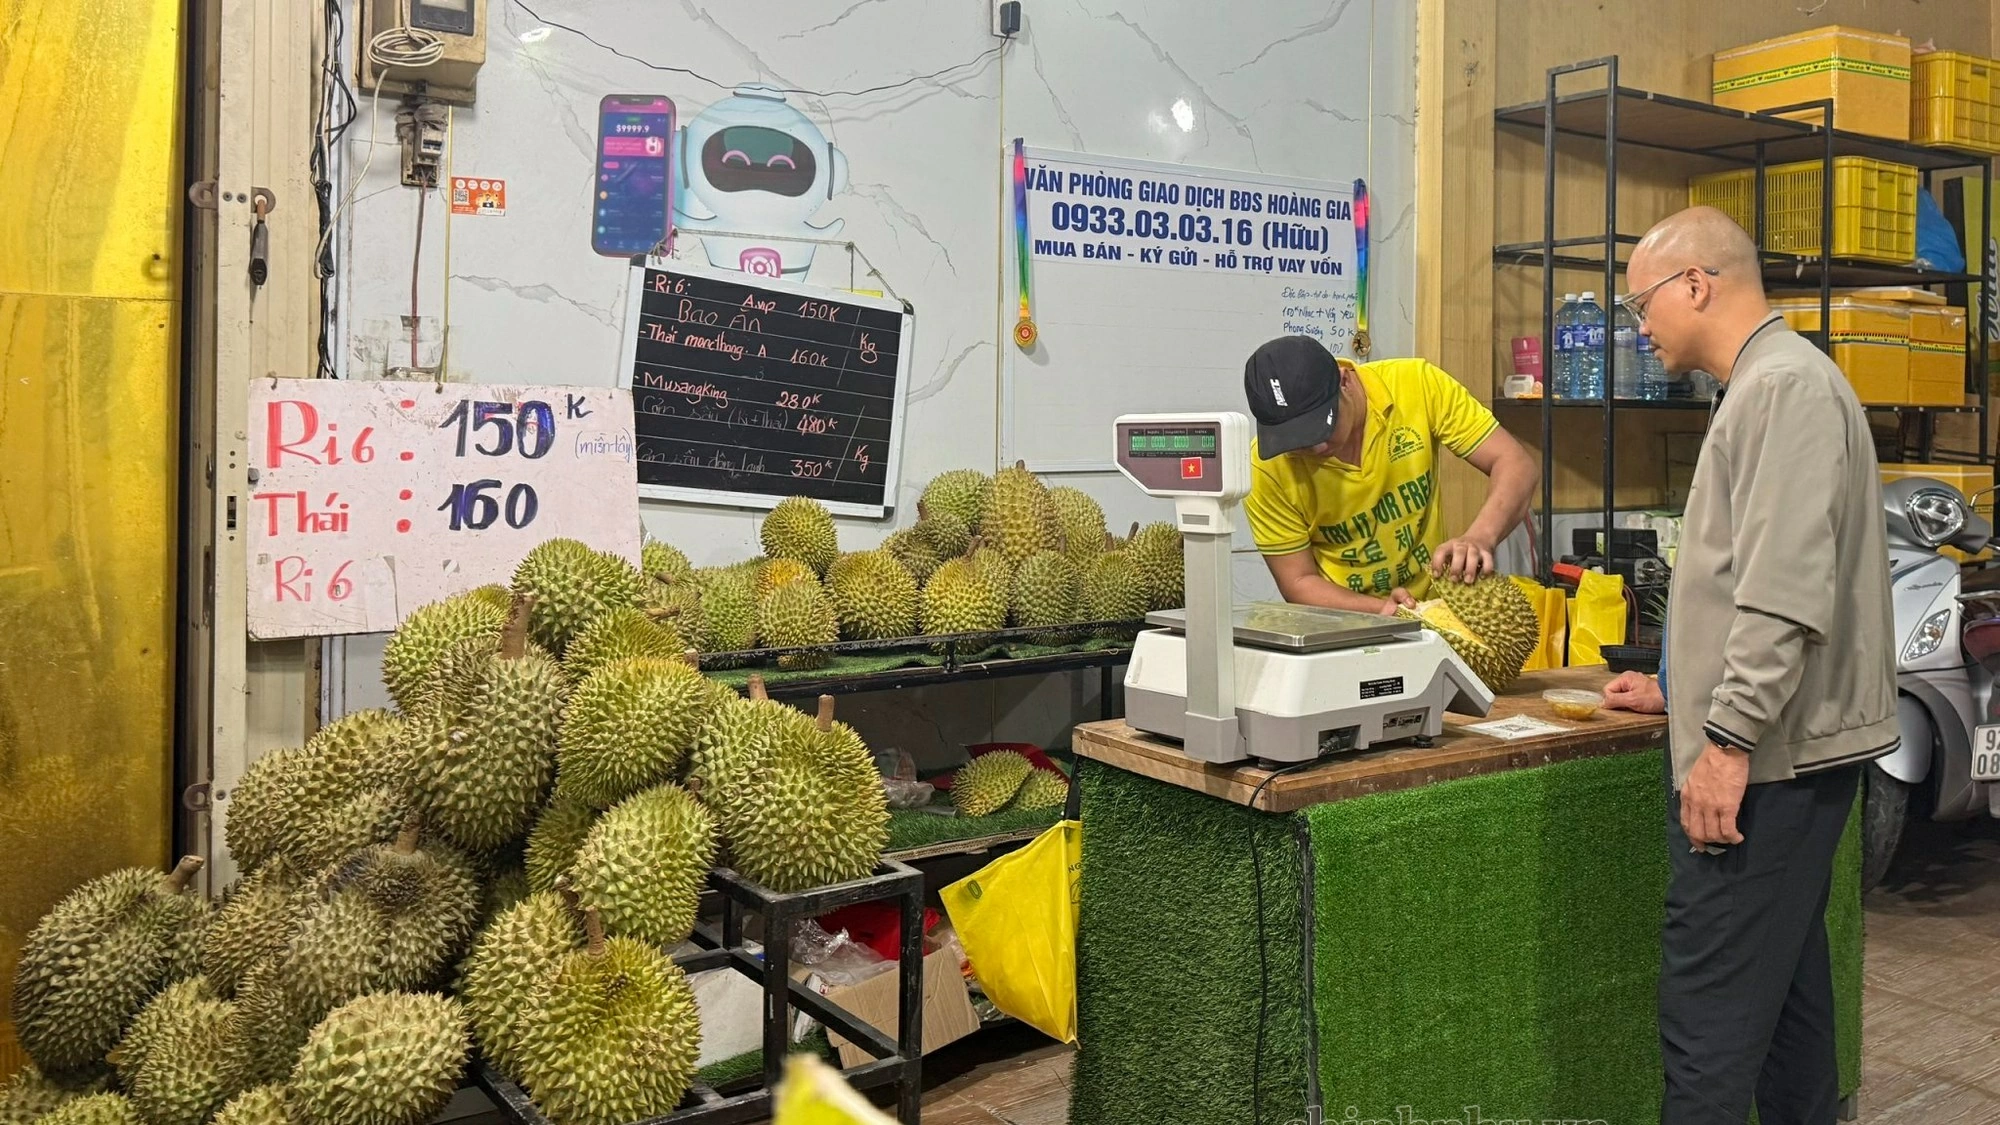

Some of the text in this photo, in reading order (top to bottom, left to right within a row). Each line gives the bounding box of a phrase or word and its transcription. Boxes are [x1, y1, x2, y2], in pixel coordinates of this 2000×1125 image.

[1024, 164, 1352, 221] VĂN PHÒNG GIAO DỊCH BĐS HOÀNG GIA
[1052, 201, 1329, 254] 0933.03.03.16 (Hữu)
[1034, 239, 1077, 258] MUA
[1083, 242, 1122, 260] BÁN
[1140, 246, 1164, 264] KÝ
[1168, 247, 1198, 266] GỬI
[1215, 249, 1238, 269] HỖ
[1242, 255, 1274, 274] TRỢ
[1278, 257, 1306, 274] VAY
[1310, 256, 1343, 276] VỐN
[678, 298, 719, 326] Bao
[266, 399, 342, 468] Ri
[350, 426, 375, 466] 6
[253, 490, 350, 537] Thái
[437, 479, 539, 531] 160
[1351, 511, 1372, 539] IT
[275, 555, 354, 602] Ri 6
